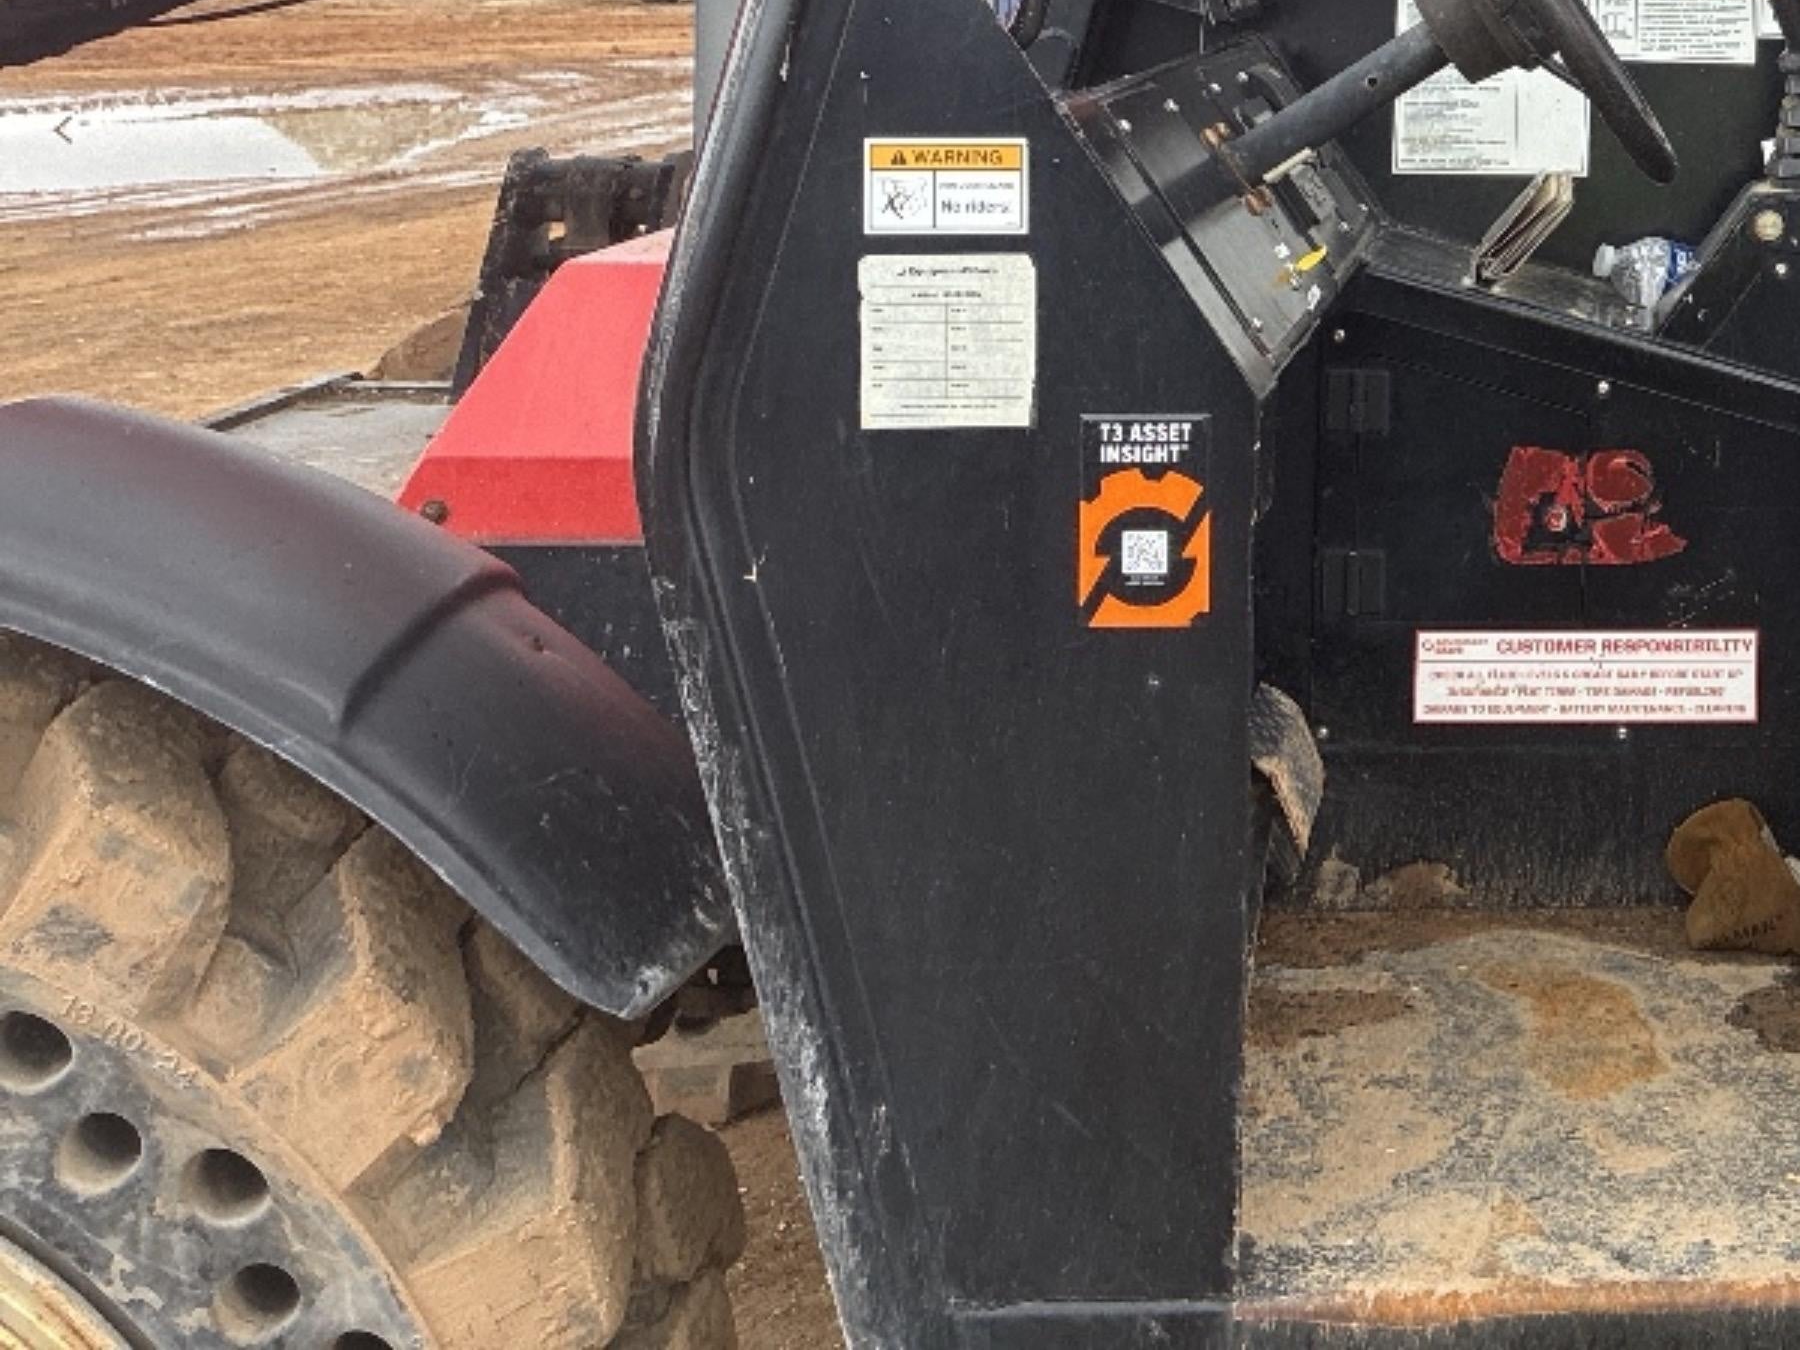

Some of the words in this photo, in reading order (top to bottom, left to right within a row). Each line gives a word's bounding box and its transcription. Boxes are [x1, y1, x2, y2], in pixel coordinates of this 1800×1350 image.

[911, 149, 1003, 166] WARNING
[1100, 422, 1123, 442] T3
[1130, 422, 1192, 442] ASSET
[1496, 638, 1597, 655] CUSTOMER
